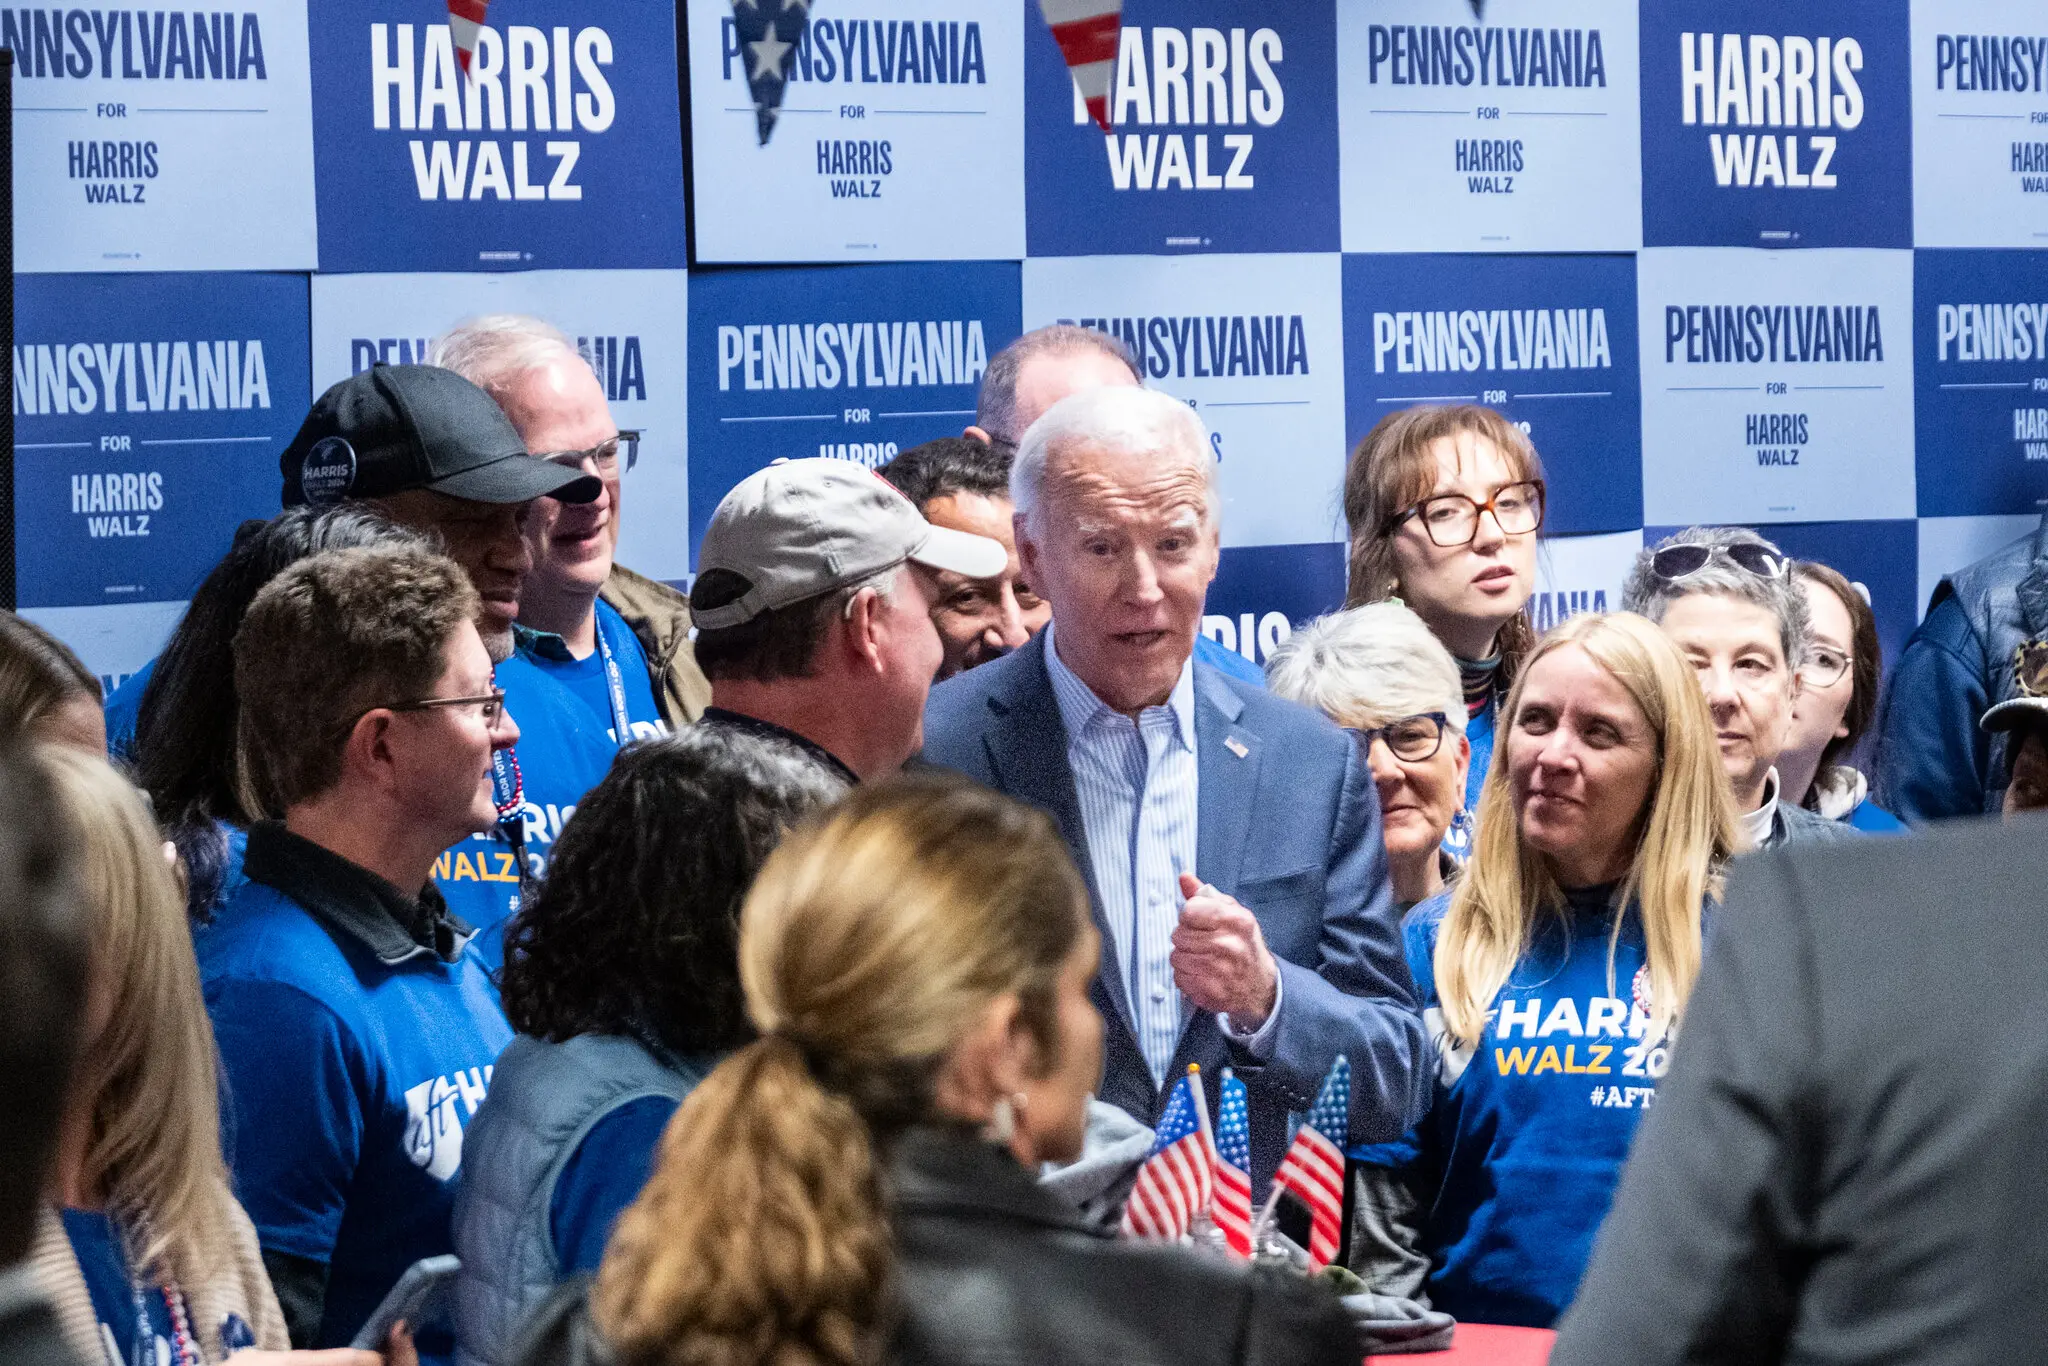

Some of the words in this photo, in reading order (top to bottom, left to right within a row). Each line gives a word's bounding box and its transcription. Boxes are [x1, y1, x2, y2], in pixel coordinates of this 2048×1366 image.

[2, 8, 267, 80] NNSYLVANIA
[721, 16, 986, 84] PNSYLVANIA
[1369, 24, 1607, 87] PENNSYLVANIA
[371, 23, 615, 132] HARRIS
[1681, 32, 1864, 129] HARRIS
[1937, 34, 2048, 92] PENNSY
[97, 103, 126, 118] FOR
[840, 105, 865, 118] FOR
[1476, 107, 1500, 119] FOR
[68, 140, 158, 179] HARRIS
[409, 141, 582, 200] WALZ
[817, 140, 892, 175] HARRIS
[1105, 134, 1254, 189] WALZ
[1455, 139, 1524, 172] HARRIS
[1709, 134, 1837, 188] WALZ
[85, 184, 145, 203] WALZ
[831, 180, 881, 198] WALZ
[1468, 176, 1513, 193] WALZ
[1057, 315, 1309, 379] NSYLVANIA
[1373, 308, 1611, 373] PENNSYLVANIA
[1666, 305, 1884, 363] PENNSYLVANIA
[1938, 303, 2048, 360] PENNSY
[718, 320, 990, 391] PENNSYLVANIA
[13, 340, 271, 415] NNSYLVANIA
[1766, 382, 1787, 394] FOR
[1484, 390, 1507, 403] FOR
[844, 408, 870, 423] FOR
[1746, 413, 1808, 445] HARRIS
[101, 435, 131, 450] FOR
[1758, 449, 1799, 466] WALZ
[304, 464, 349, 479] HARRIS
[72, 472, 164, 513] HARRIS
[88, 515, 150, 538] WALZ
[500, 774, 511, 801] ABOR
[1496, 997, 1655, 1039] HAR
[1496, 1045, 1613, 1076] WALZ
[1590, 1086, 1655, 1108] #AFT
